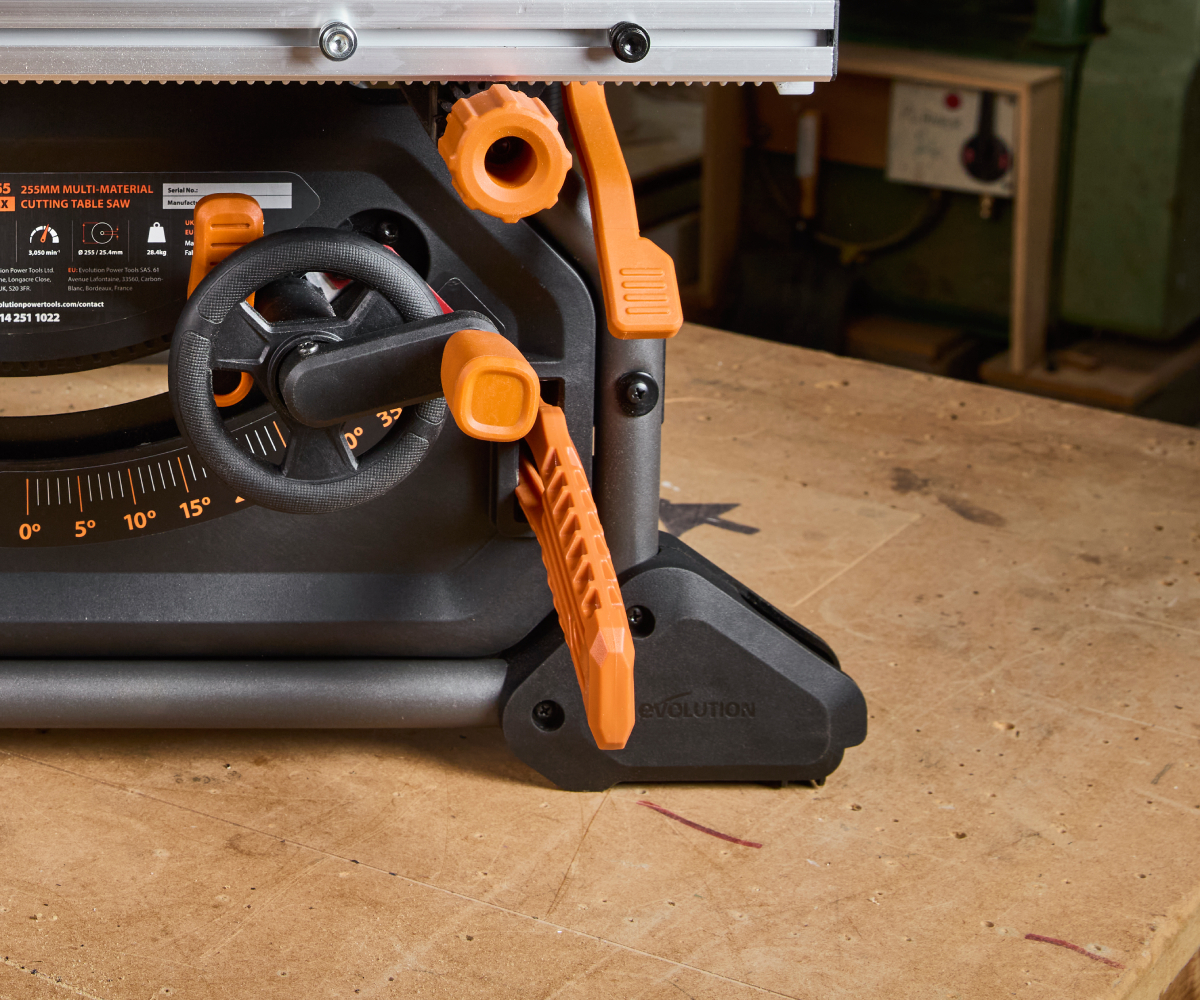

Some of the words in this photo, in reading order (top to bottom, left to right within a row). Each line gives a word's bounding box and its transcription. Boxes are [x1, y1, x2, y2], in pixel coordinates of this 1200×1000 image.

[20, 184, 60, 195] 255MM
[62, 184, 154, 194] MULTI-MATERIAL
[20, 199, 69, 209] CUTTING
[70, 199, 104, 209] TABLE
[106, 198, 131, 209] SAW
[28, 249, 46, 257] 3,050
[146, 249, 167, 257] 28.4kg
[8, 276, 35, 284] Longacre
[12, 312, 32, 323] 251
[35, 312, 61, 323] 1022
[344, 426, 364, 450] 0°
[376, 407, 403, 428] 35
